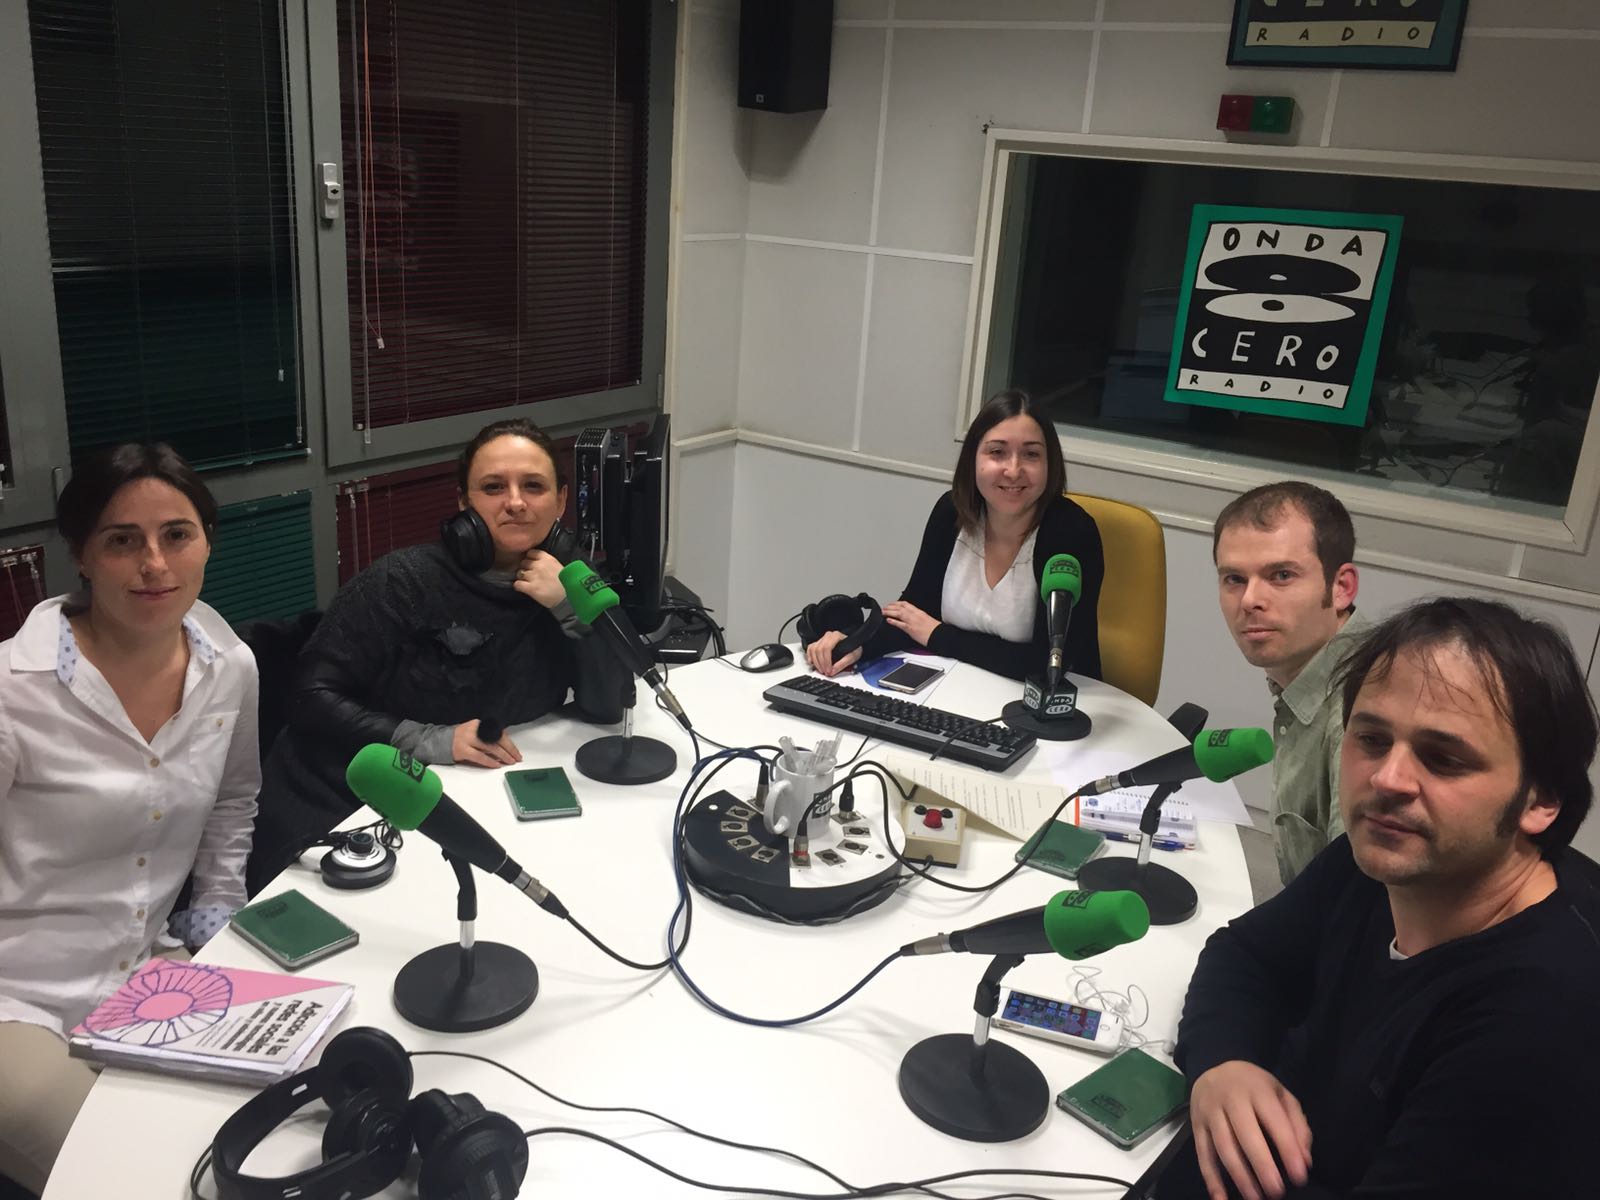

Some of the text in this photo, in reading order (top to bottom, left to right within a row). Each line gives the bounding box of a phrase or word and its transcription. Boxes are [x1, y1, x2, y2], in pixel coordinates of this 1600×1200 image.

[1256, 26, 1420, 42] RADIO
[1222, 227, 1363, 256] ONDA
[1191, 327, 1340, 371] CERO
[1189, 374, 1334, 399] RADIO
[276, 999, 303, 1021] redes
[247, 1023, 283, 1053] sociales
